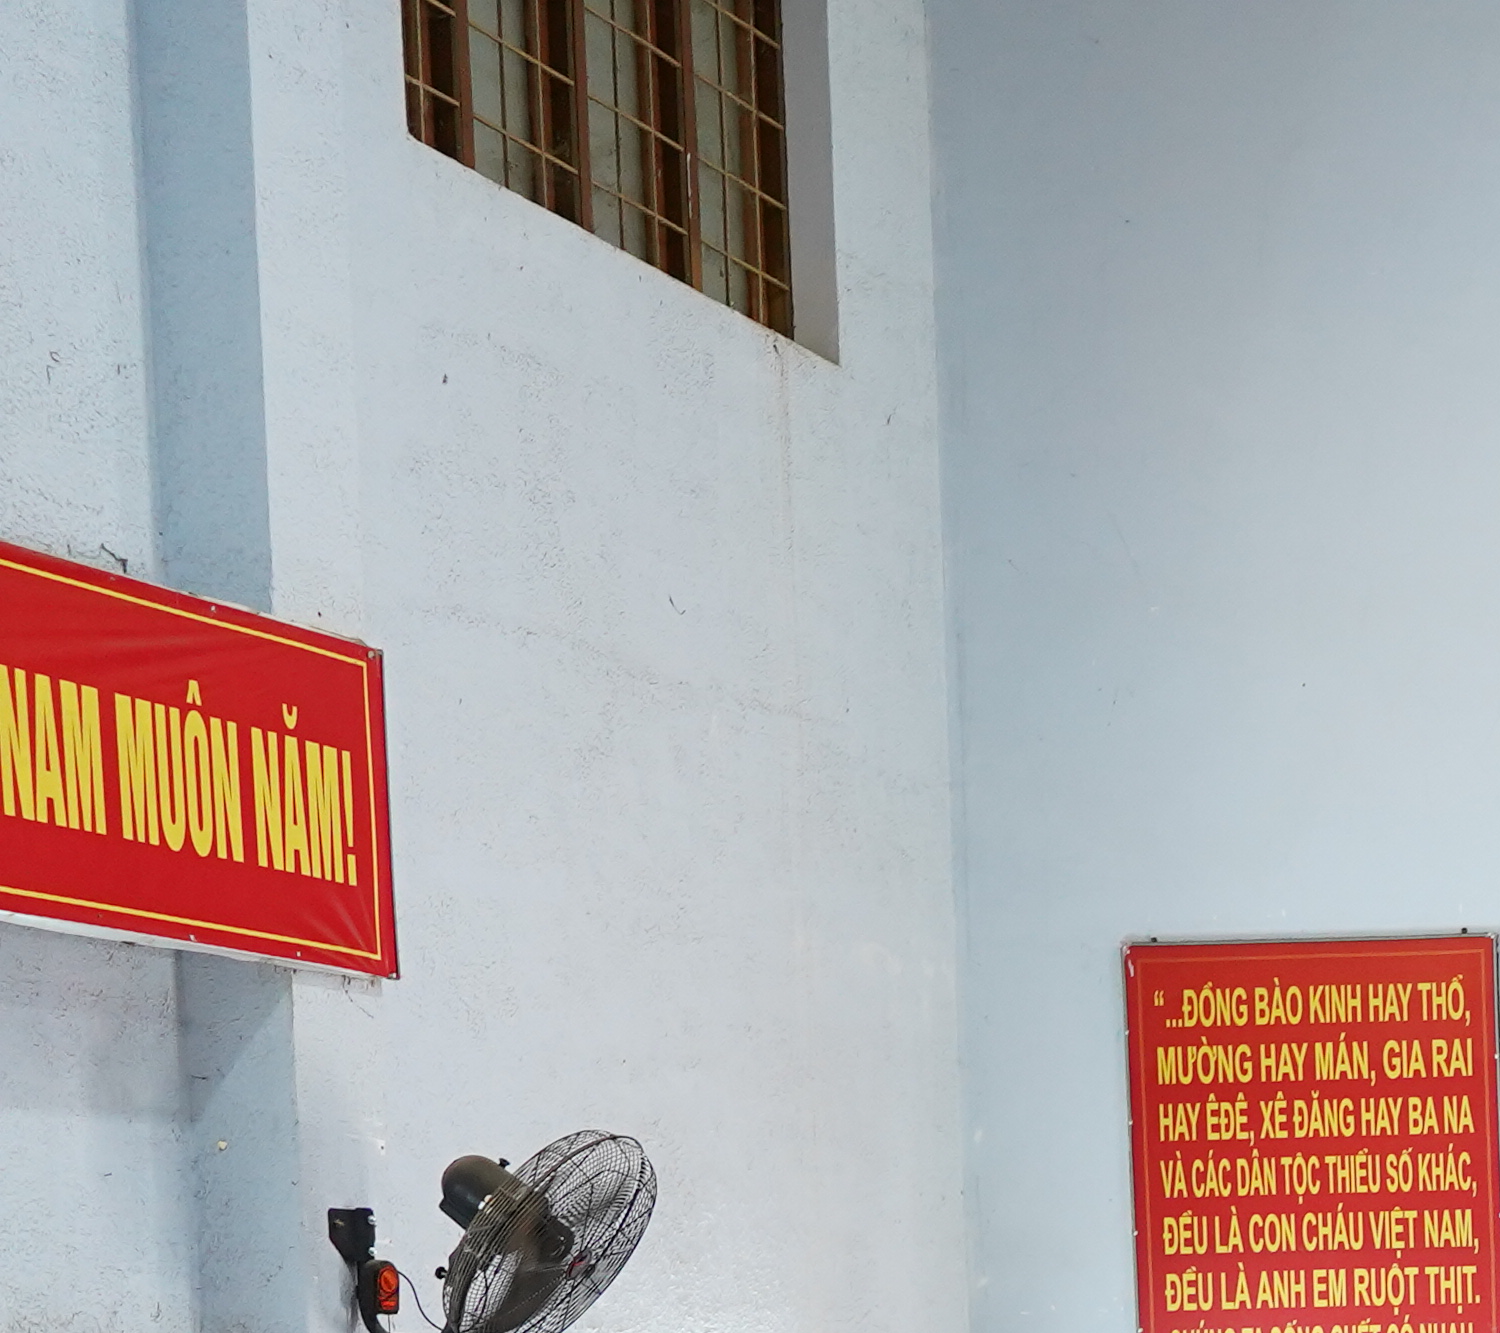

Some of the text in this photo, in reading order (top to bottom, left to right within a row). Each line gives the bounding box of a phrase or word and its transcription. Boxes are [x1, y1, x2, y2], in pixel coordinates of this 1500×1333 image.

[0, 664, 357, 886] NAM MUÔN NĂM!
[1255, 977, 1303, 1025] BÀO
[1309, 985, 1360, 1024] KINH
[1369, 983, 1412, 1022] HAY
[1418, 975, 1470, 1026] THỔ,
[1159, 1090, 1475, 1146] HAY ÊĐÊ, XÊ ĐĂNG HAY BA NA
[1163, 1204, 1478, 1258] ĐỀU LÀ CON CHÁU VIỆT NAM,
